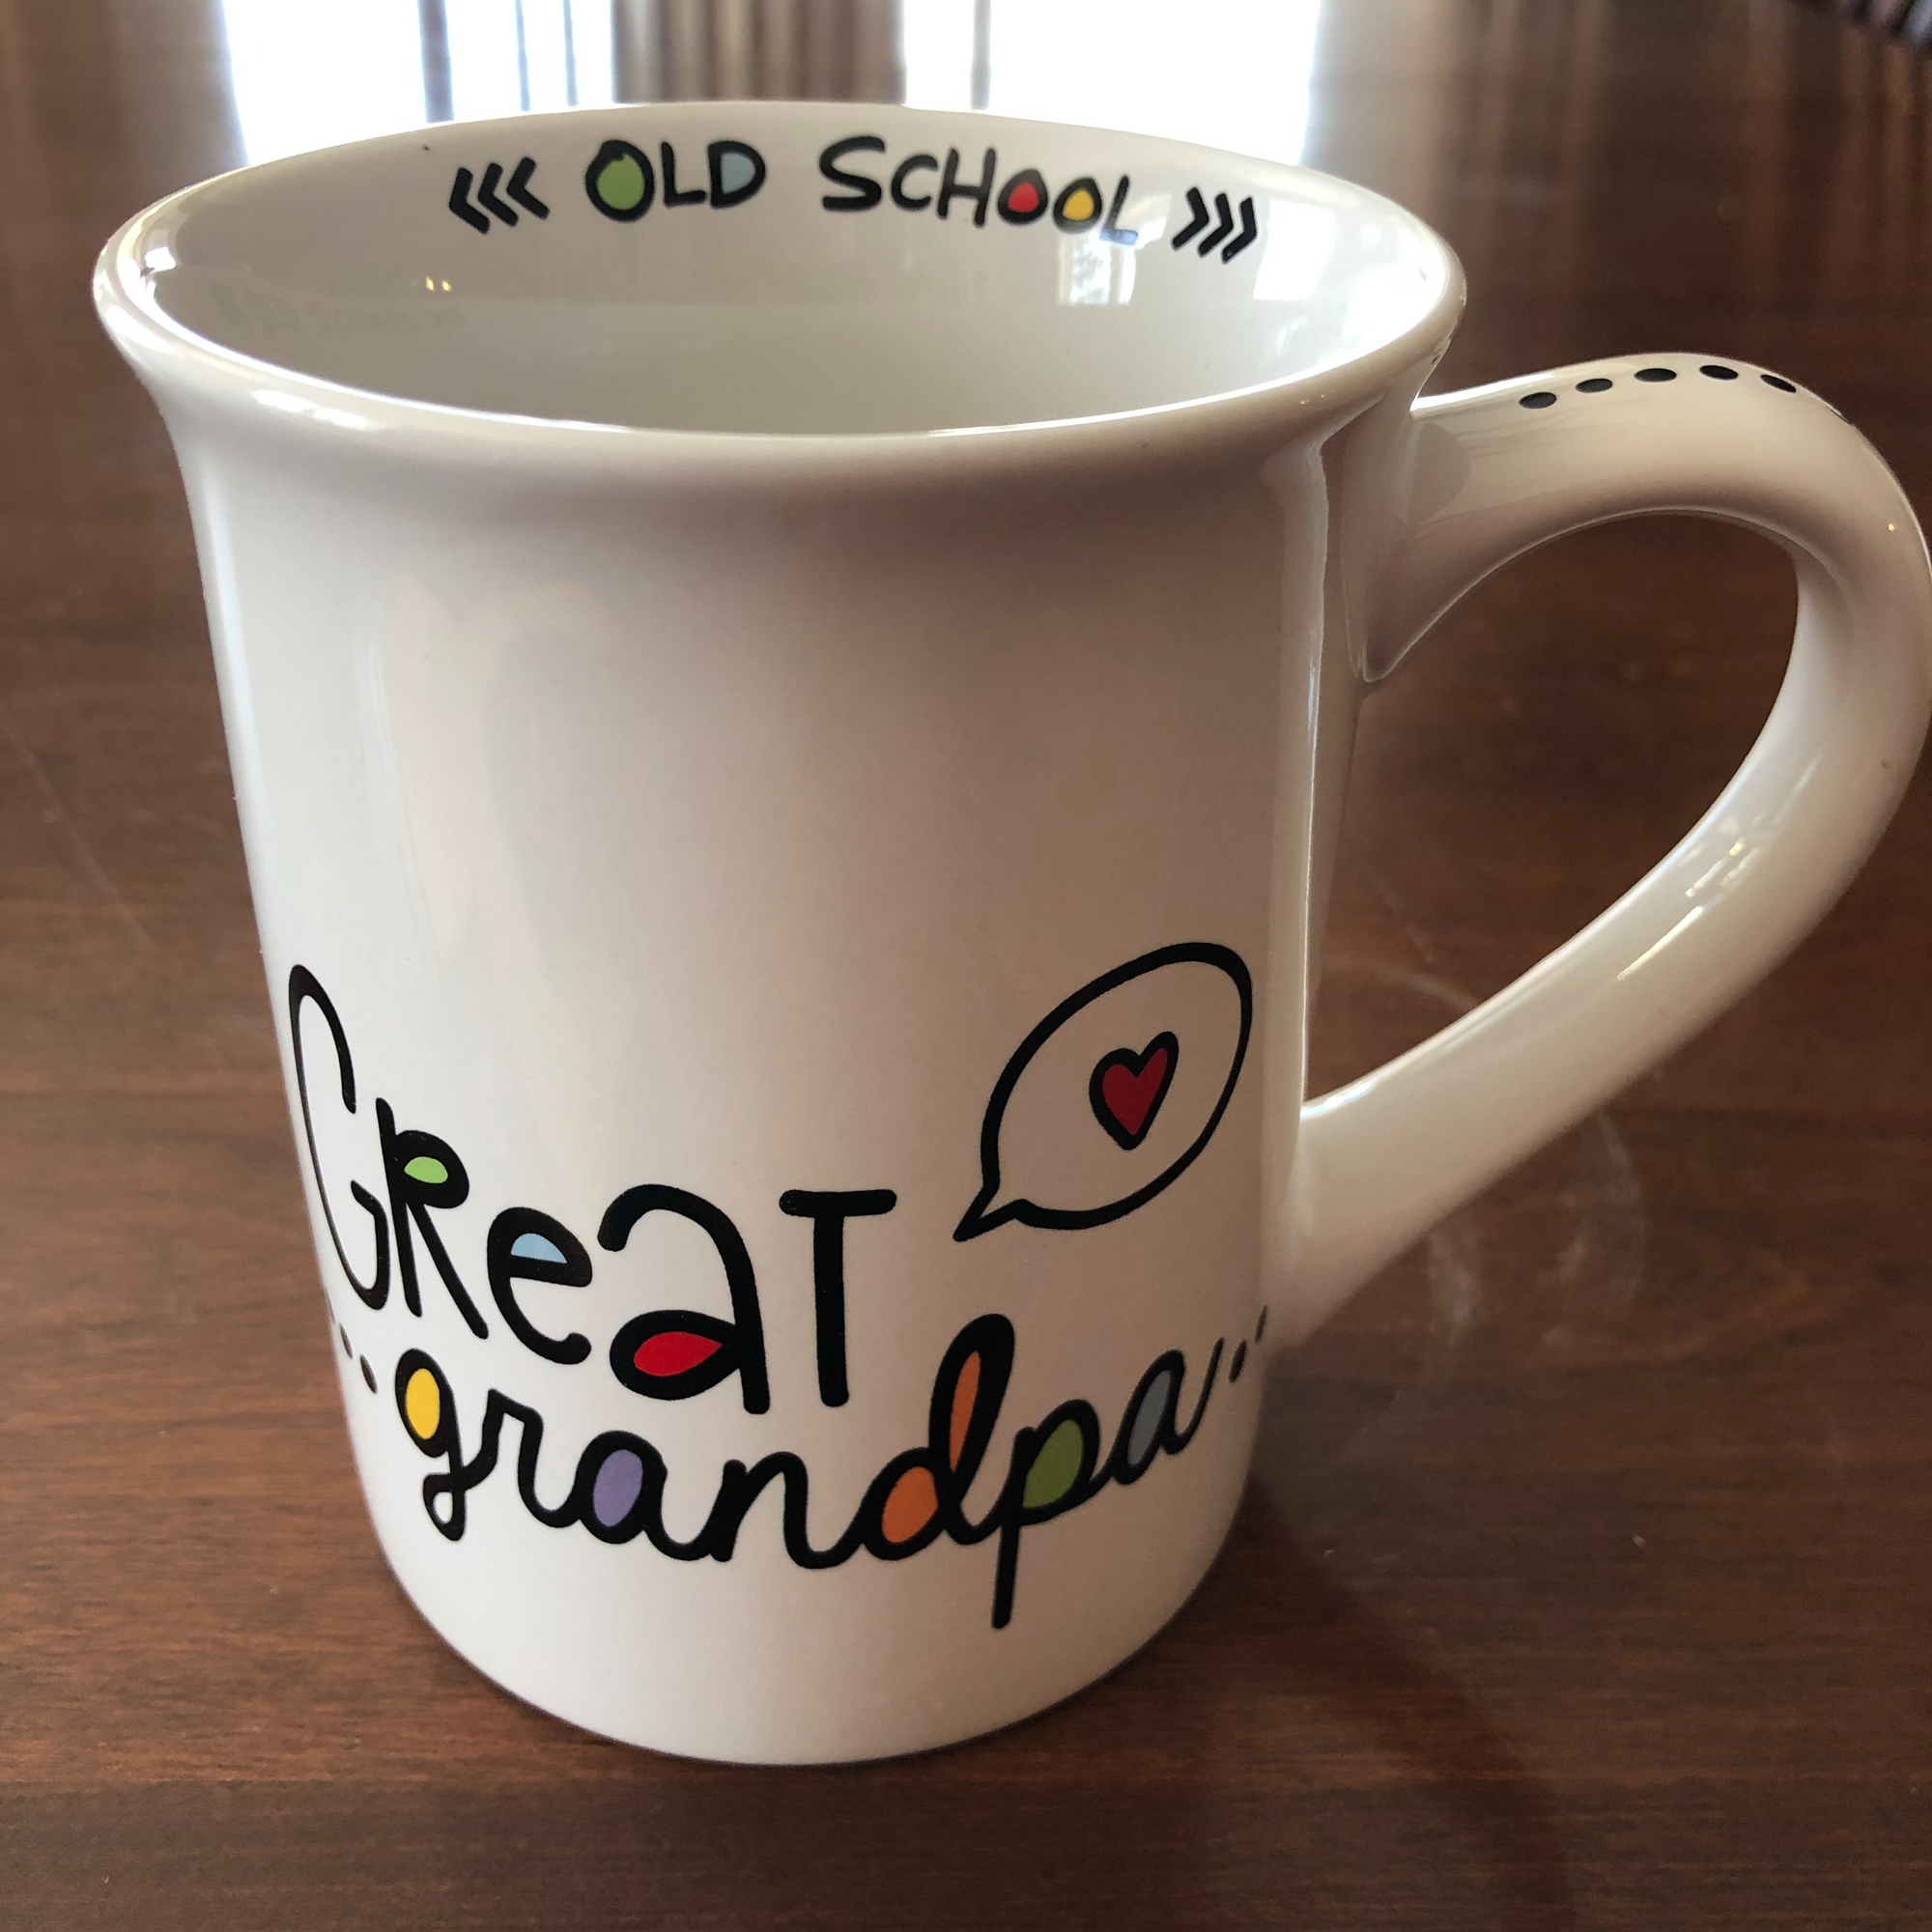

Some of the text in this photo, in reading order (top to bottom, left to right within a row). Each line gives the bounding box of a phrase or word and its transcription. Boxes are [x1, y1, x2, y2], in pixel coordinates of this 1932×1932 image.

[584, 135, 1139, 246] OLD SCHOOL
[394, 1313, 1227, 1631] grandpa
